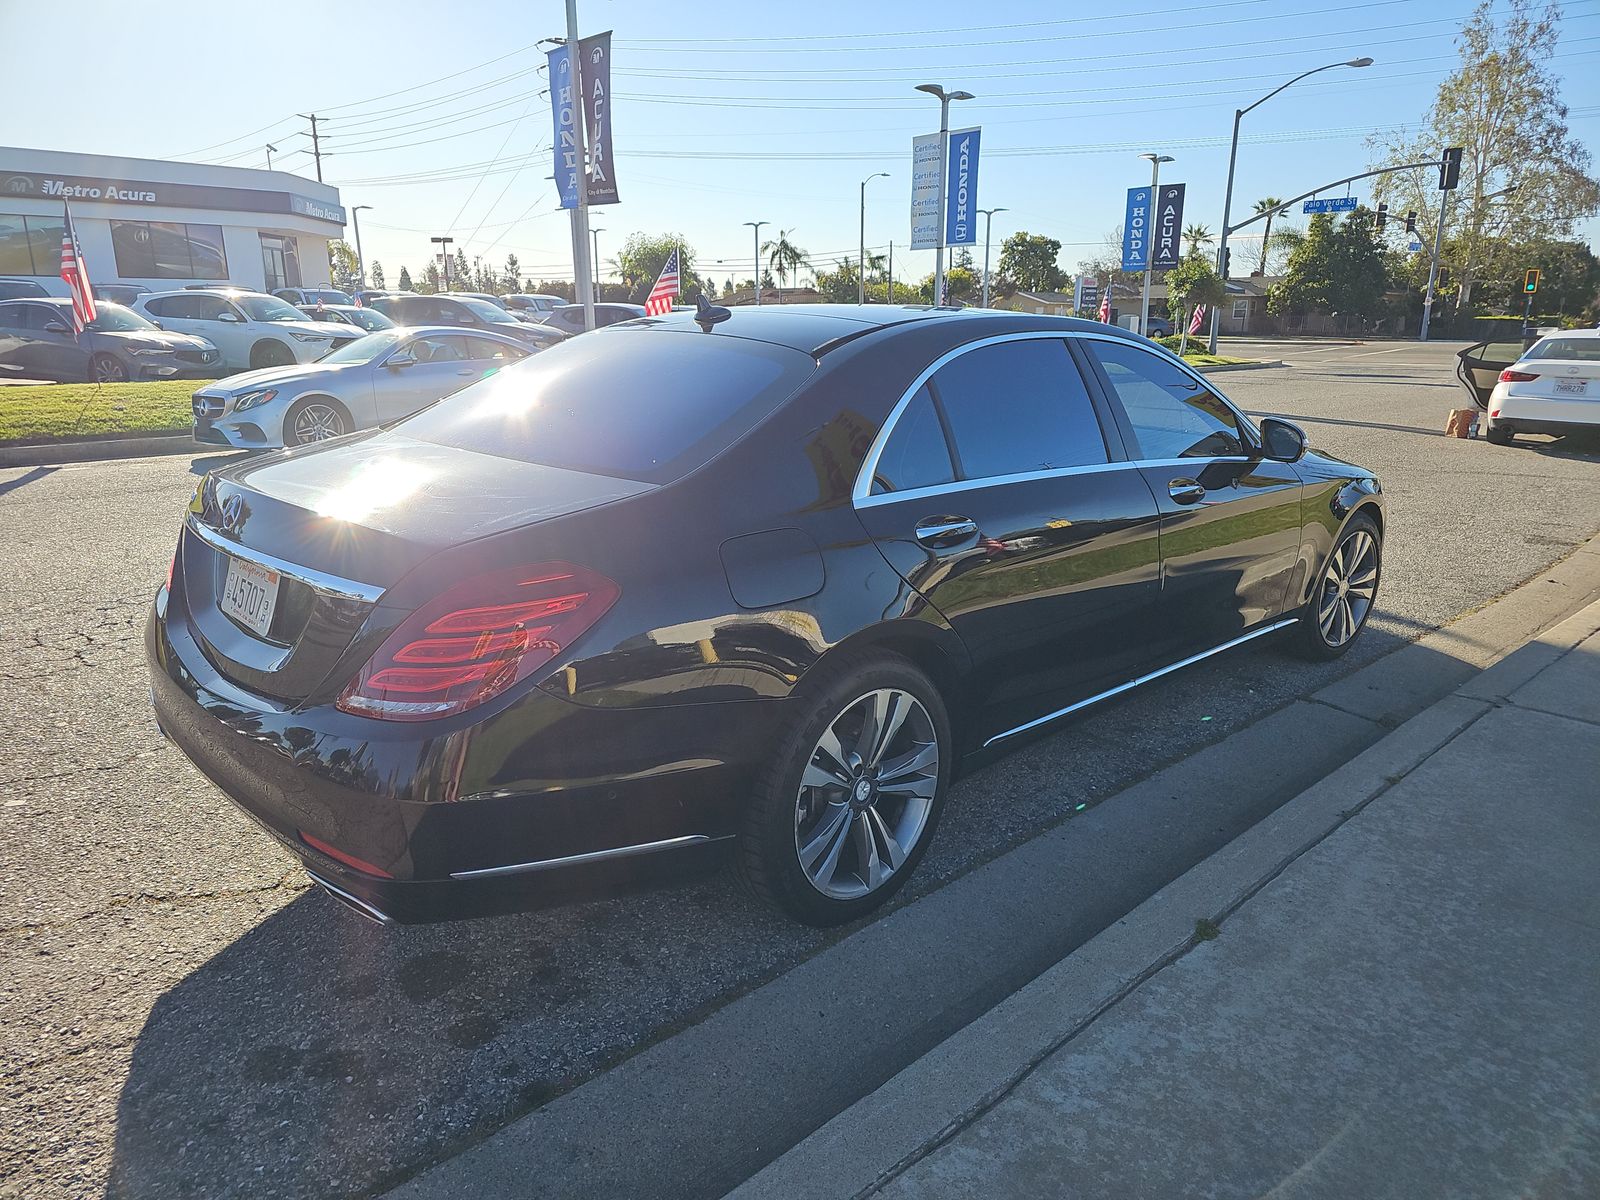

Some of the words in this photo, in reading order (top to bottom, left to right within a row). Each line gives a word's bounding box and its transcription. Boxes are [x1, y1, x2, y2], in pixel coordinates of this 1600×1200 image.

[592, 79, 607, 183] ACURA
[42, 179, 101, 199] Metro
[105, 186, 156, 202] Acura
[957, 136, 970, 222] HONDA
[1304, 200, 1321, 208] Palo
[1323, 198, 1345, 206] Verde
[1347, 197, 1357, 205] St
[1129, 207, 1145, 260] HONDA
[1159, 204, 1175, 259] ACURA
[232, 575, 266, 620] 45707
